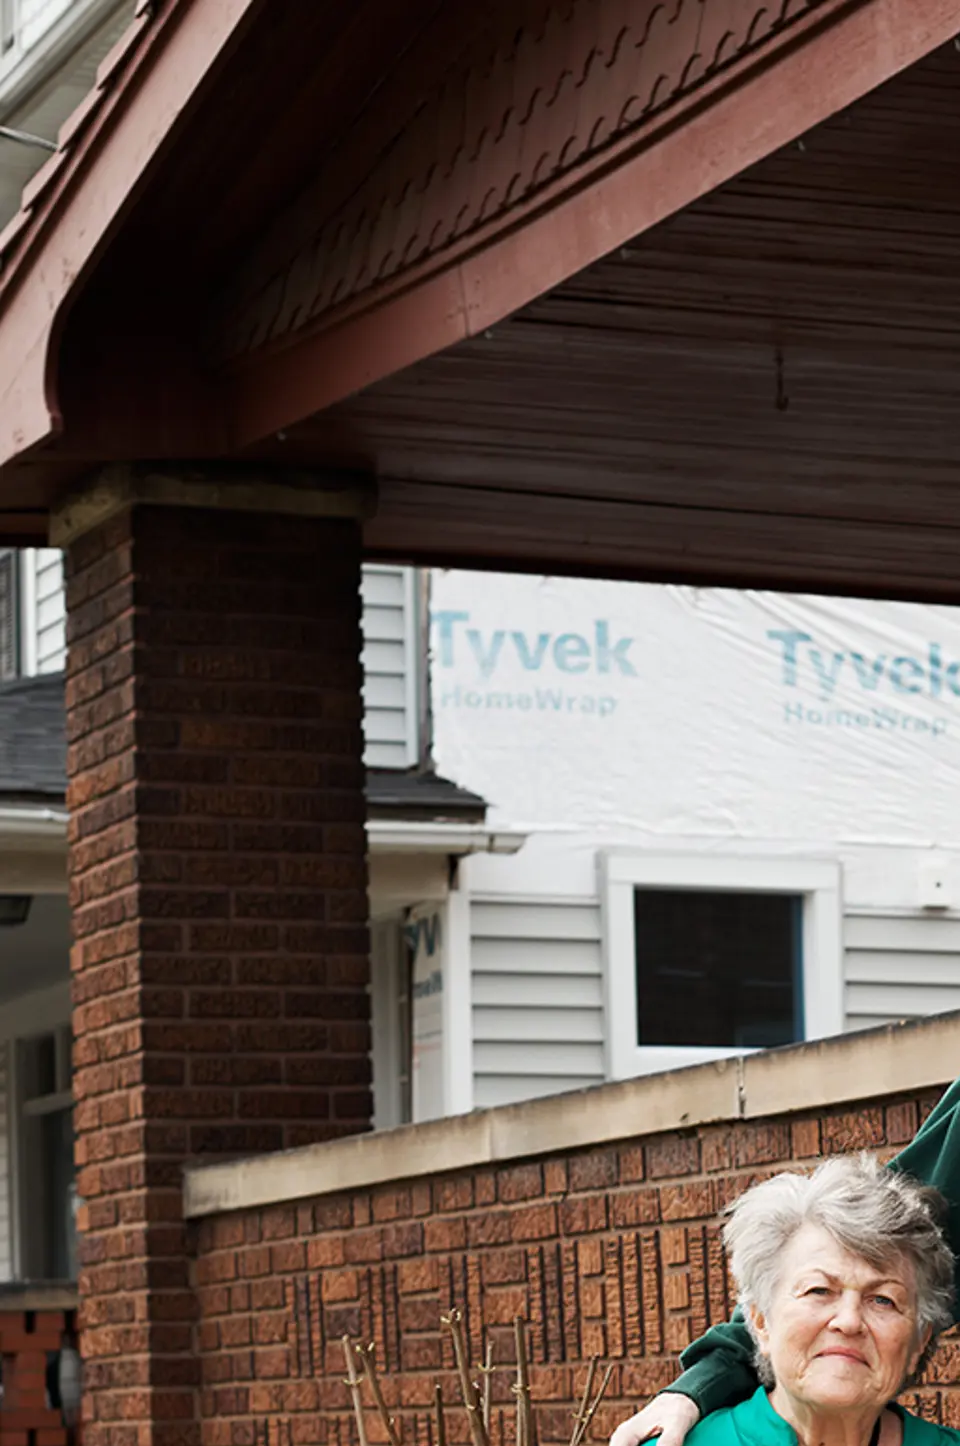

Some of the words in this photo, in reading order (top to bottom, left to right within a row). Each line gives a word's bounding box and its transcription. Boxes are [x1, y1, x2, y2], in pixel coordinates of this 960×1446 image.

[431, 610, 638, 684] Tyvek
[441, 683, 619, 717] HomeWrap
[783, 701, 948, 738] HomeWrap
